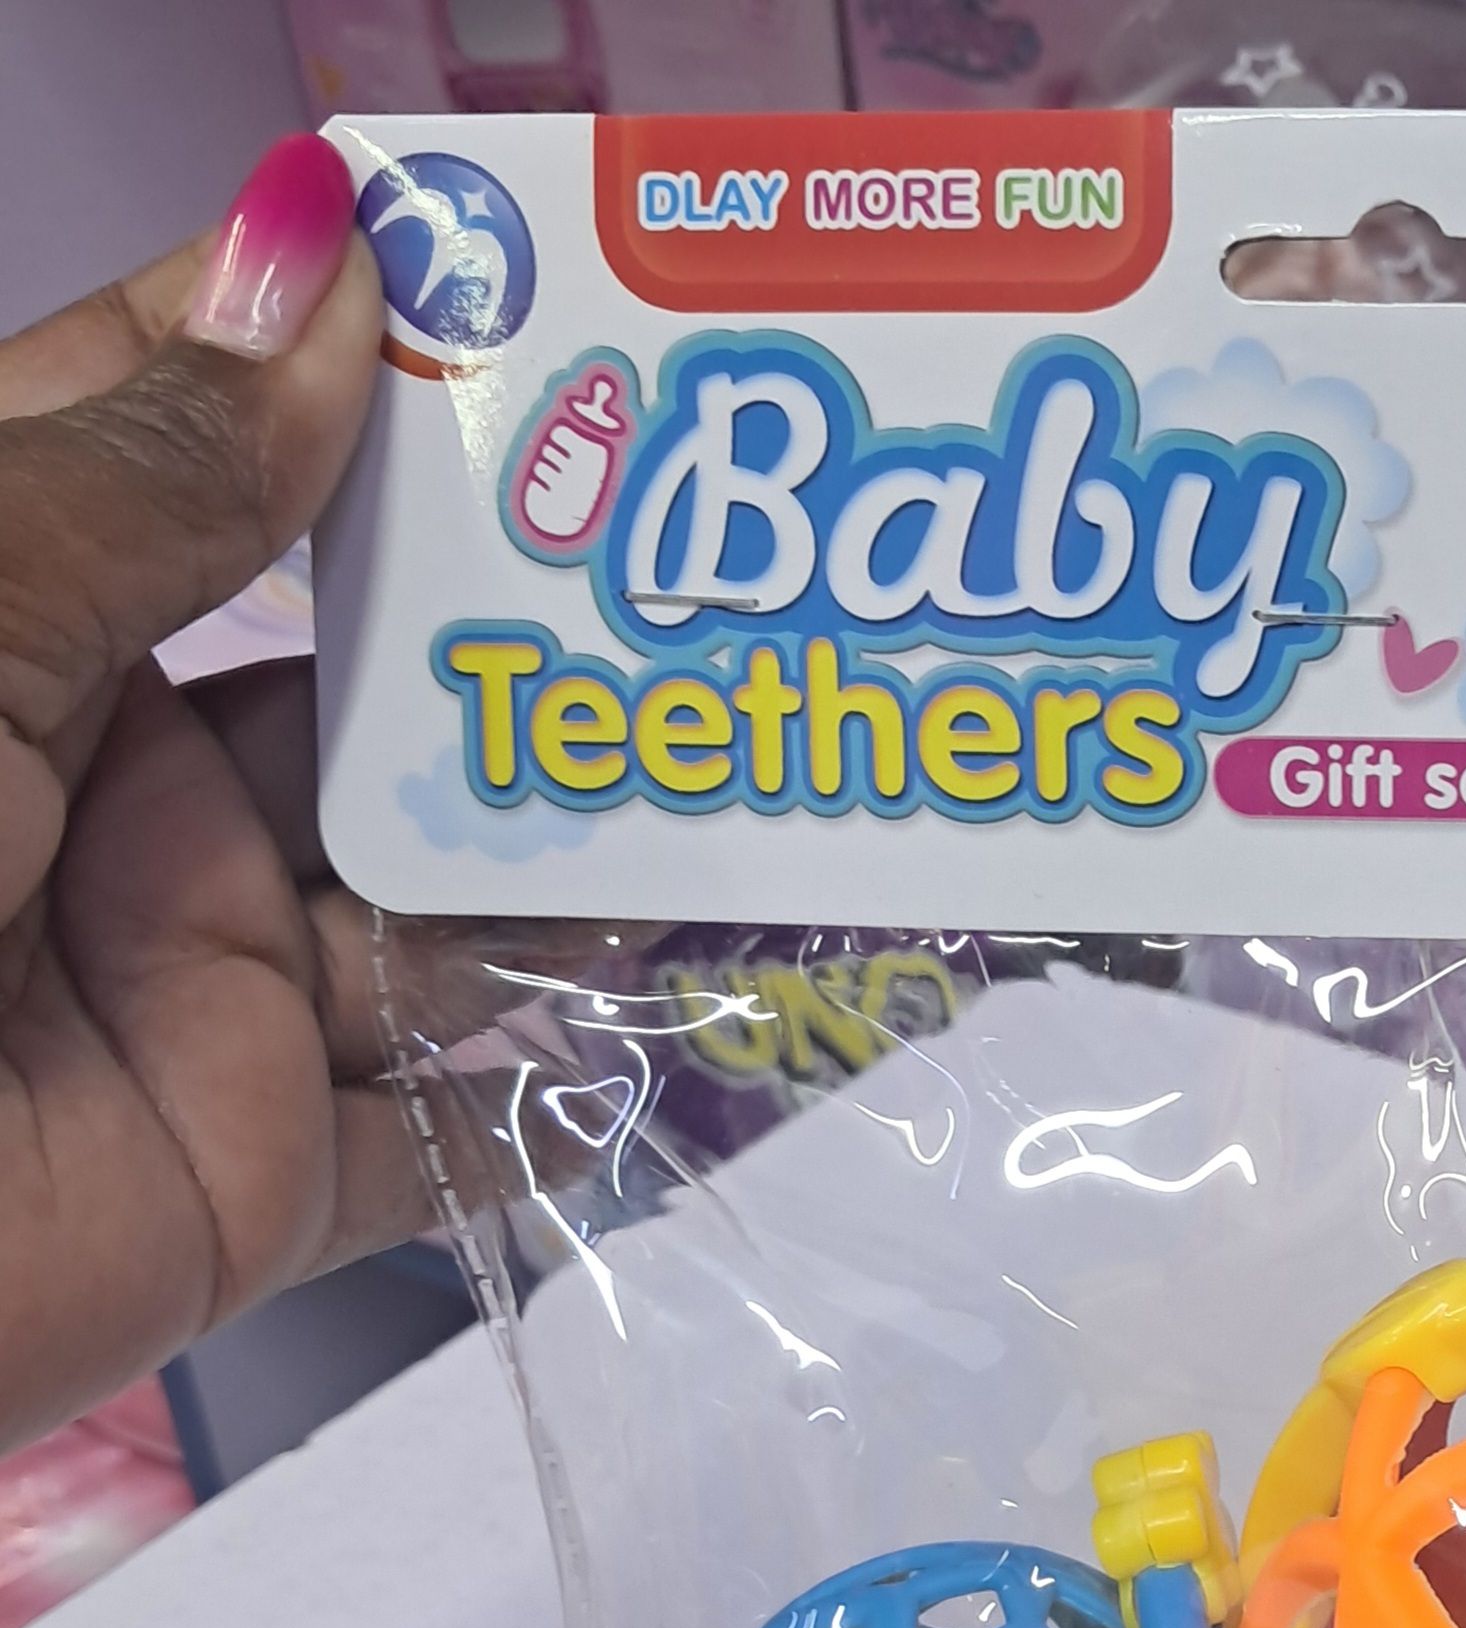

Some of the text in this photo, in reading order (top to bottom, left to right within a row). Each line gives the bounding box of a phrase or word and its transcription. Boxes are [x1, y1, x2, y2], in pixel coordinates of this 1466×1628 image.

[642, 173, 1118, 225] DLAY MORE FUN
[624, 371, 1304, 699] Baby
[448, 637, 1185, 806] Teethers
[1268, 743, 1403, 809] Gift
